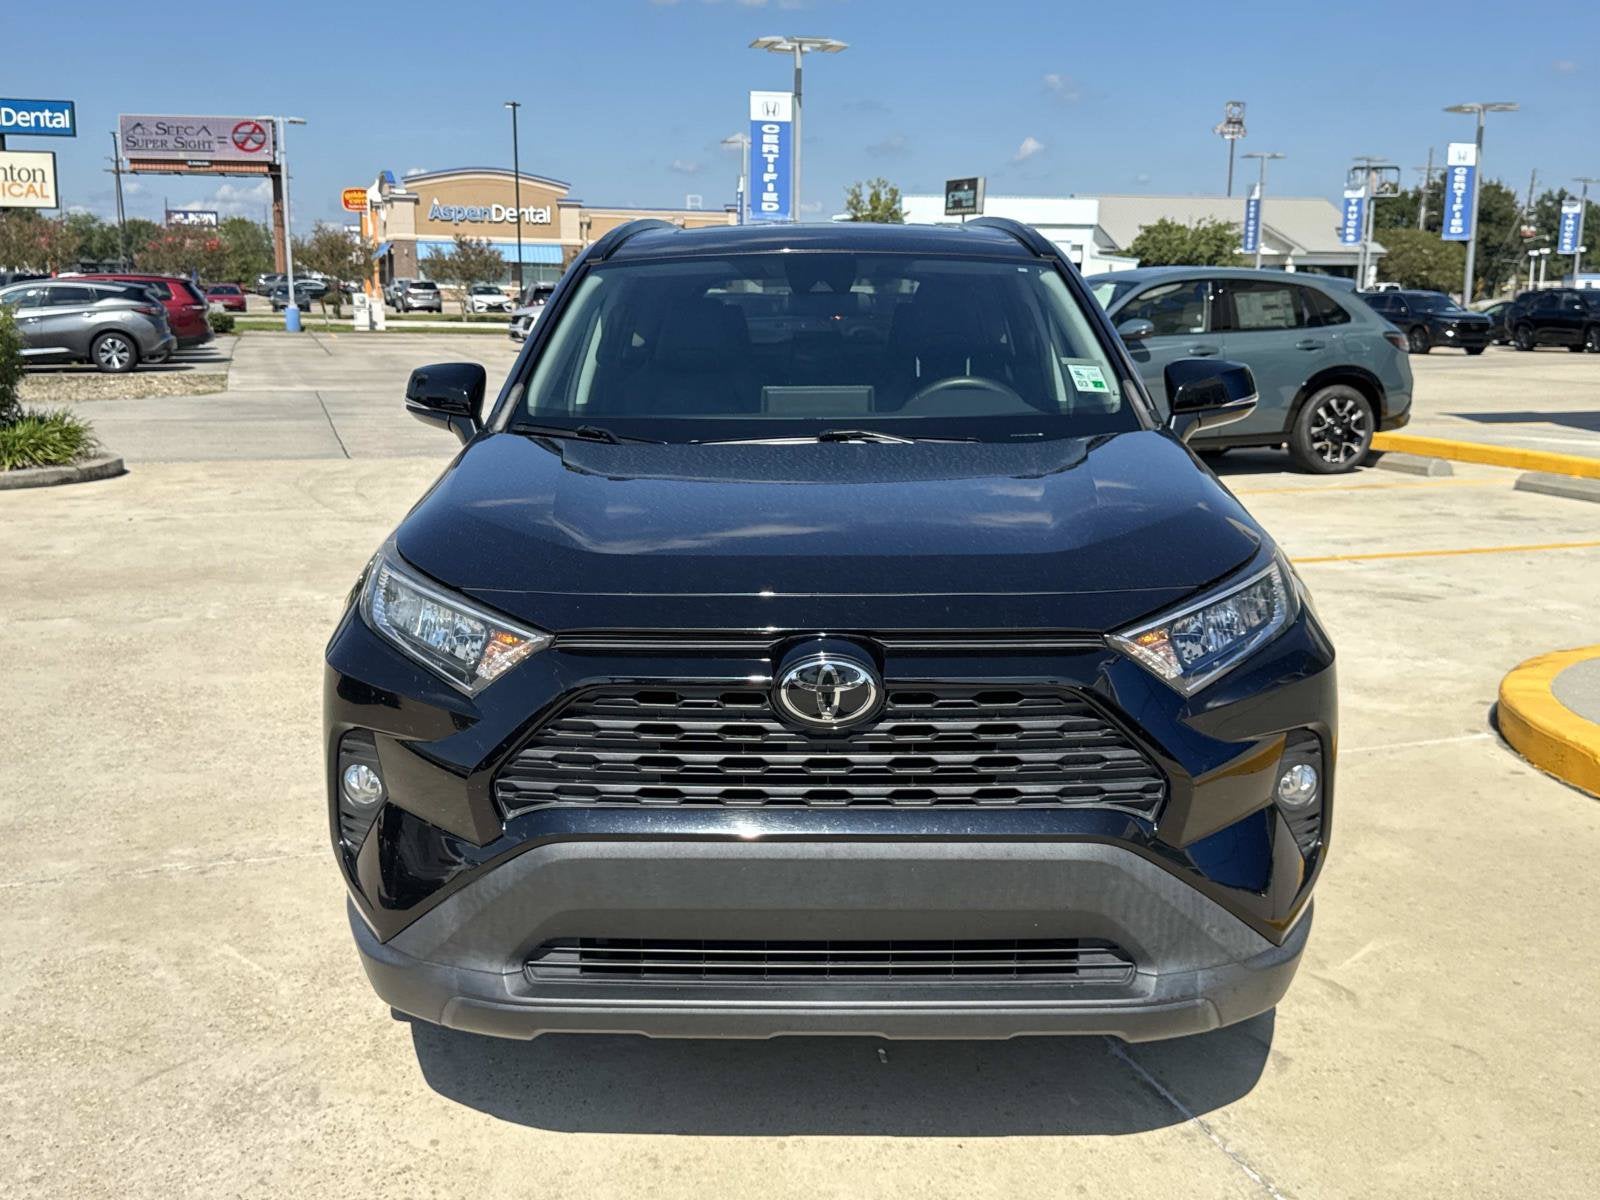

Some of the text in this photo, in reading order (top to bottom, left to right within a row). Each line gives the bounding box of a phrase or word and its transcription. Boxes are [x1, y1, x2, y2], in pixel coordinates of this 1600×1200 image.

[0, 107, 70, 128] Dental
[125, 136, 214, 150] SUPER SIGHT
[761, 124, 780, 211] CERTIFIED
[1449, 167, 1468, 234] CERTIFIED
